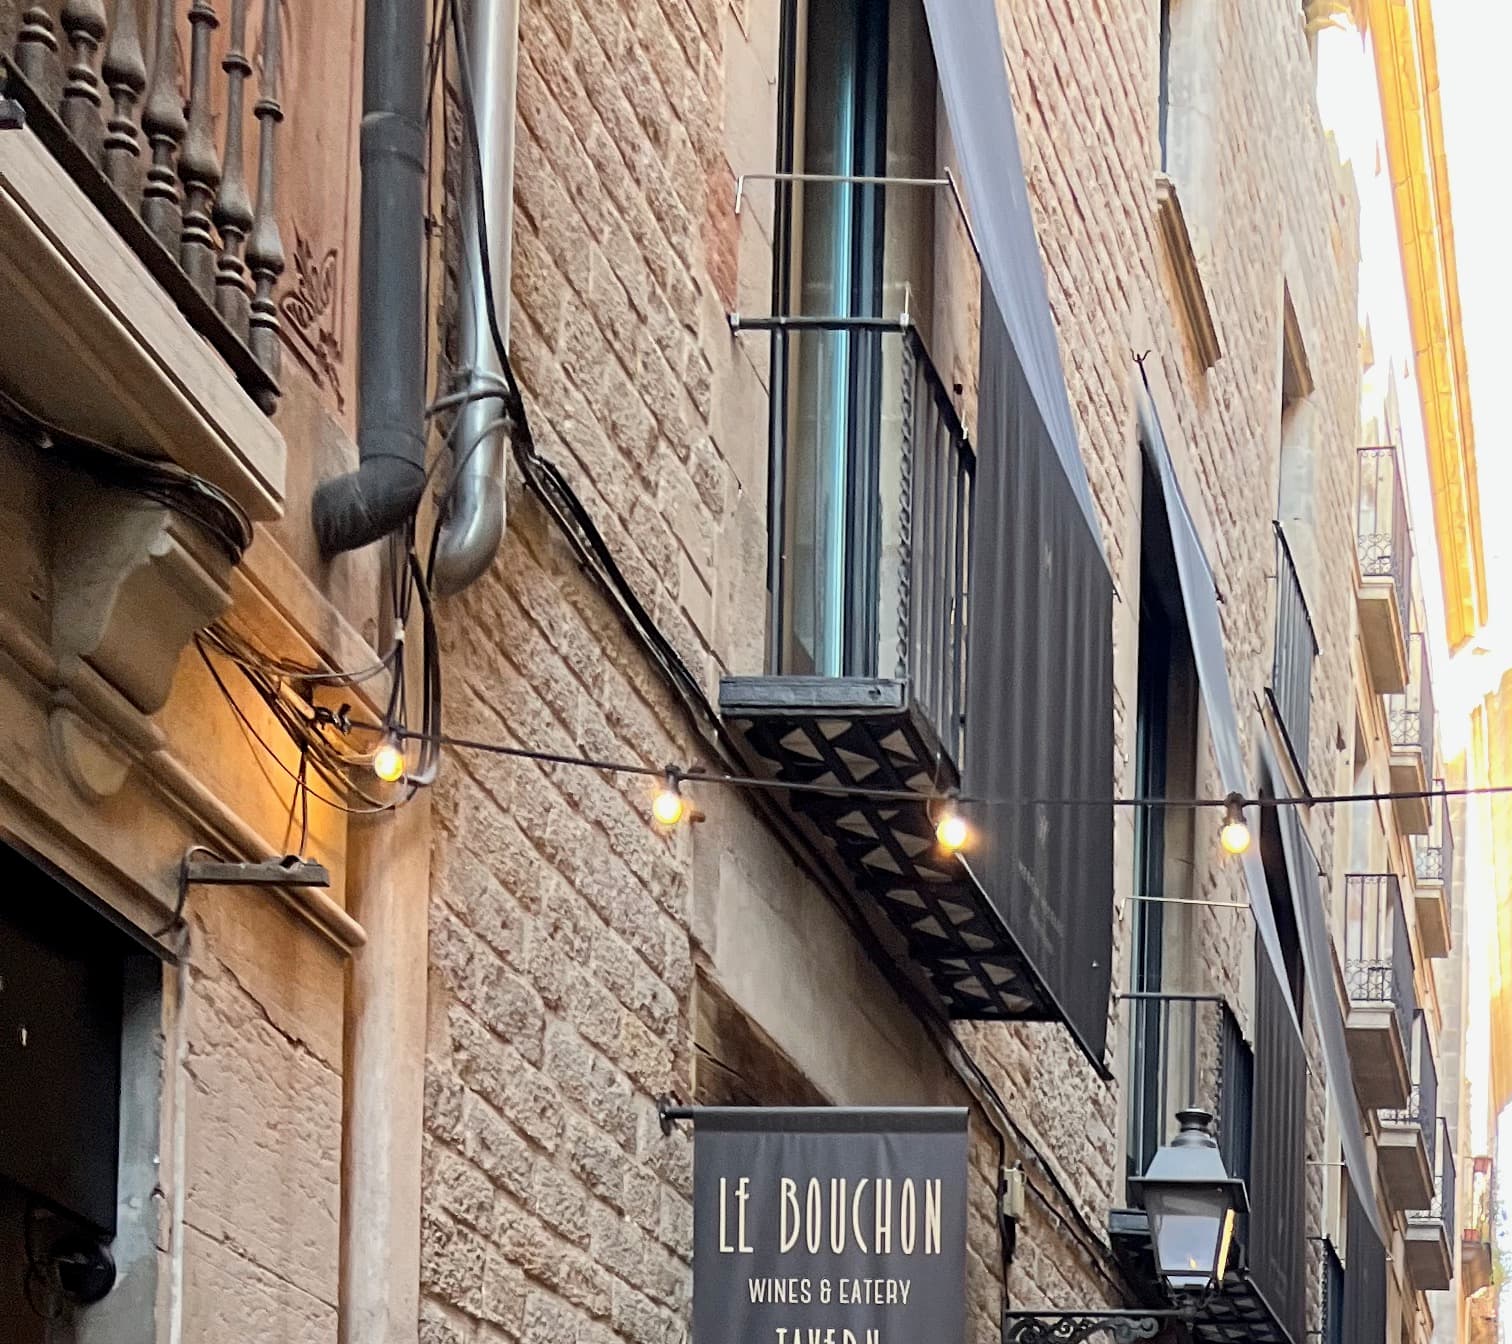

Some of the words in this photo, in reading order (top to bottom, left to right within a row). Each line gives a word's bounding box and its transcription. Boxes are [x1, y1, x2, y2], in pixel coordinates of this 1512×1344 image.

[719, 1177, 753, 1253] LE
[780, 1177, 942, 1254] BOUCHON
[748, 1278, 812, 1304] WINES
[820, 1278, 832, 1304] &
[839, 1279, 911, 1305] EATERY
